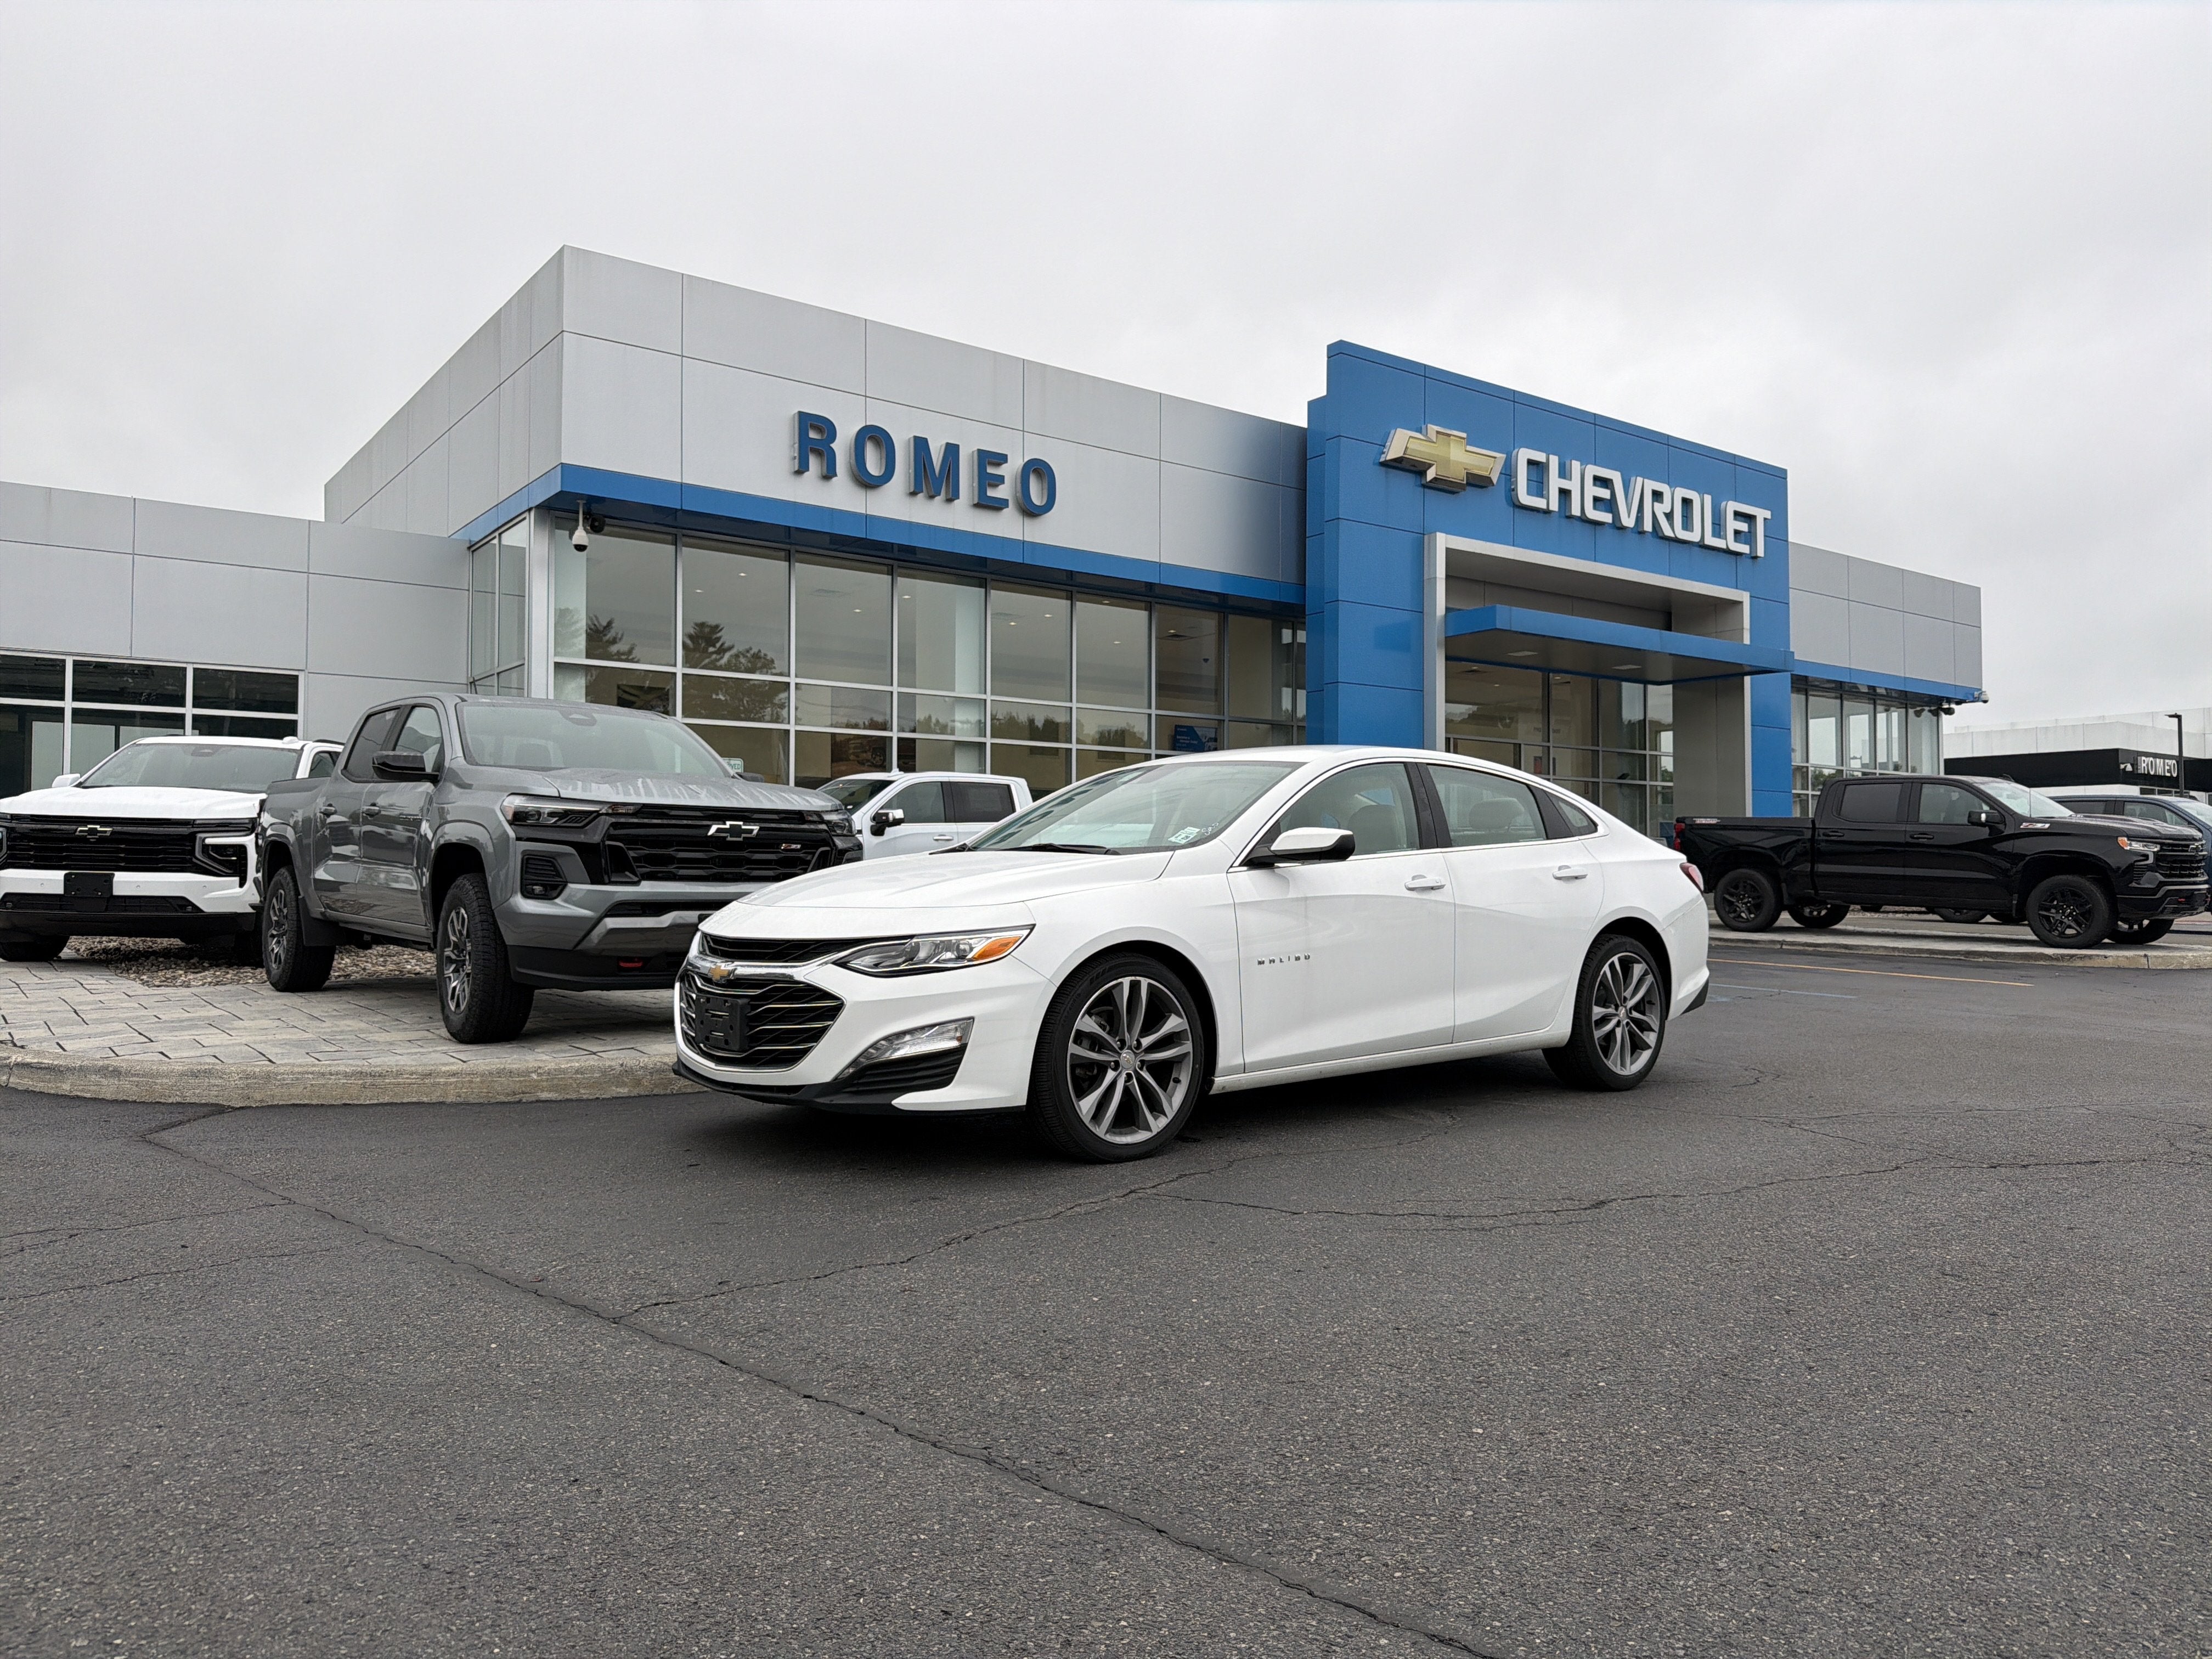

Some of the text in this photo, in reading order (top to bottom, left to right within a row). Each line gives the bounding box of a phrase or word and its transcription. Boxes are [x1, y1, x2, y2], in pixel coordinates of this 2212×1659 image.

[794, 410, 1057, 516] ROMEO
[1510, 447, 1772, 558] CHEVROLET
[2138, 756, 2177, 777] ROMEO
